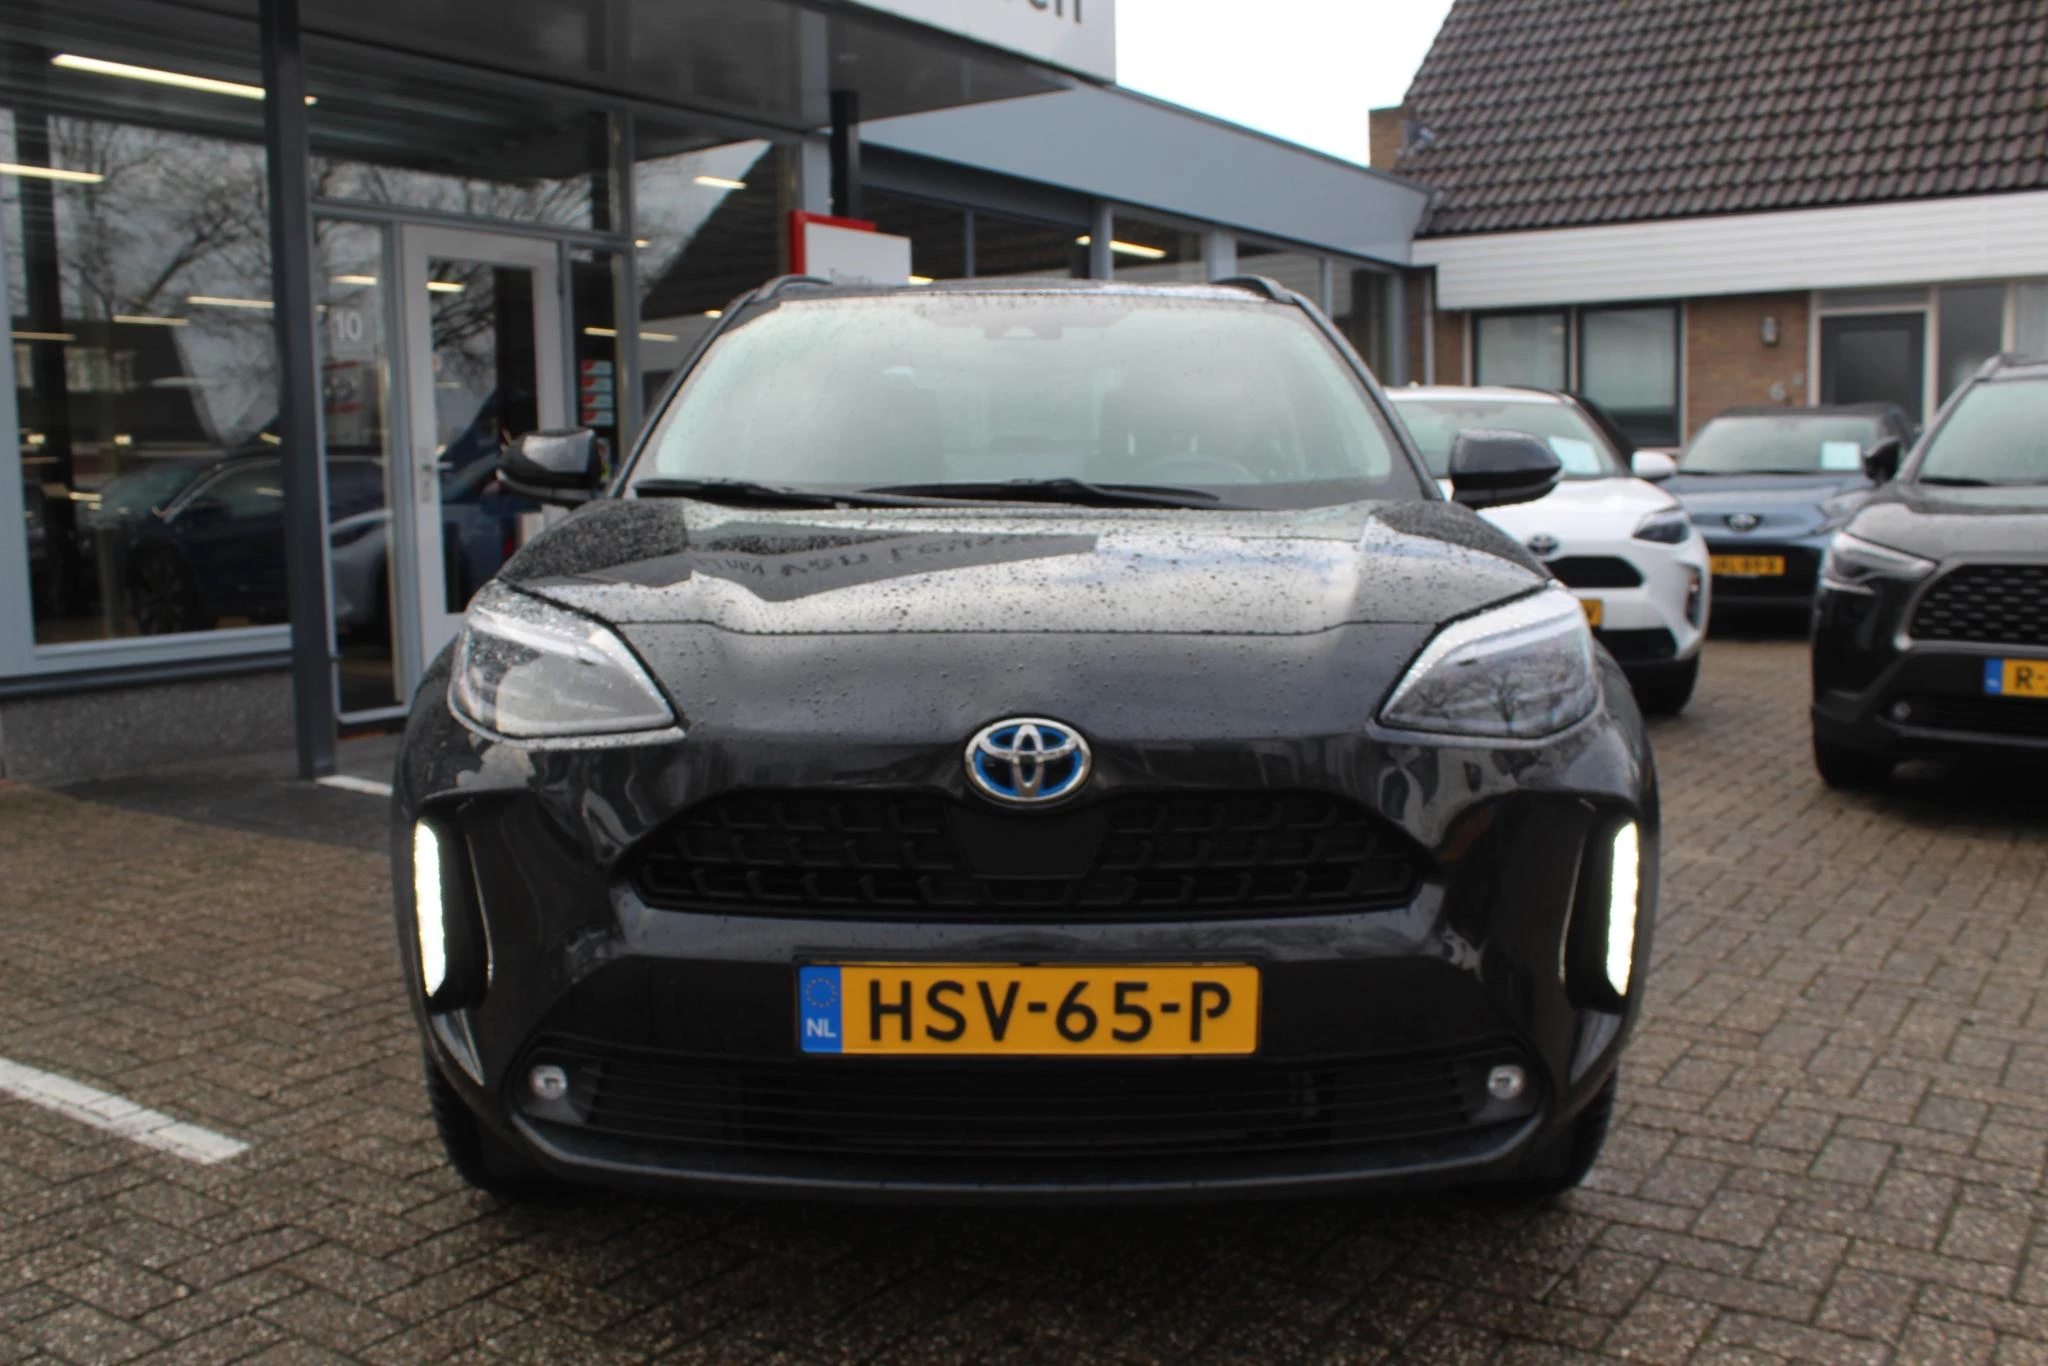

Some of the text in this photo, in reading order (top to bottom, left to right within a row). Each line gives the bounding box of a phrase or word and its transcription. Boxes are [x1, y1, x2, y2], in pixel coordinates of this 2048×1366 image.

[332, 310, 363, 342] 10
[2015, 664, 2048, 691] R-
[868, 979, 1232, 1043] HSV-65-P
[806, 1017, 837, 1038] NL
